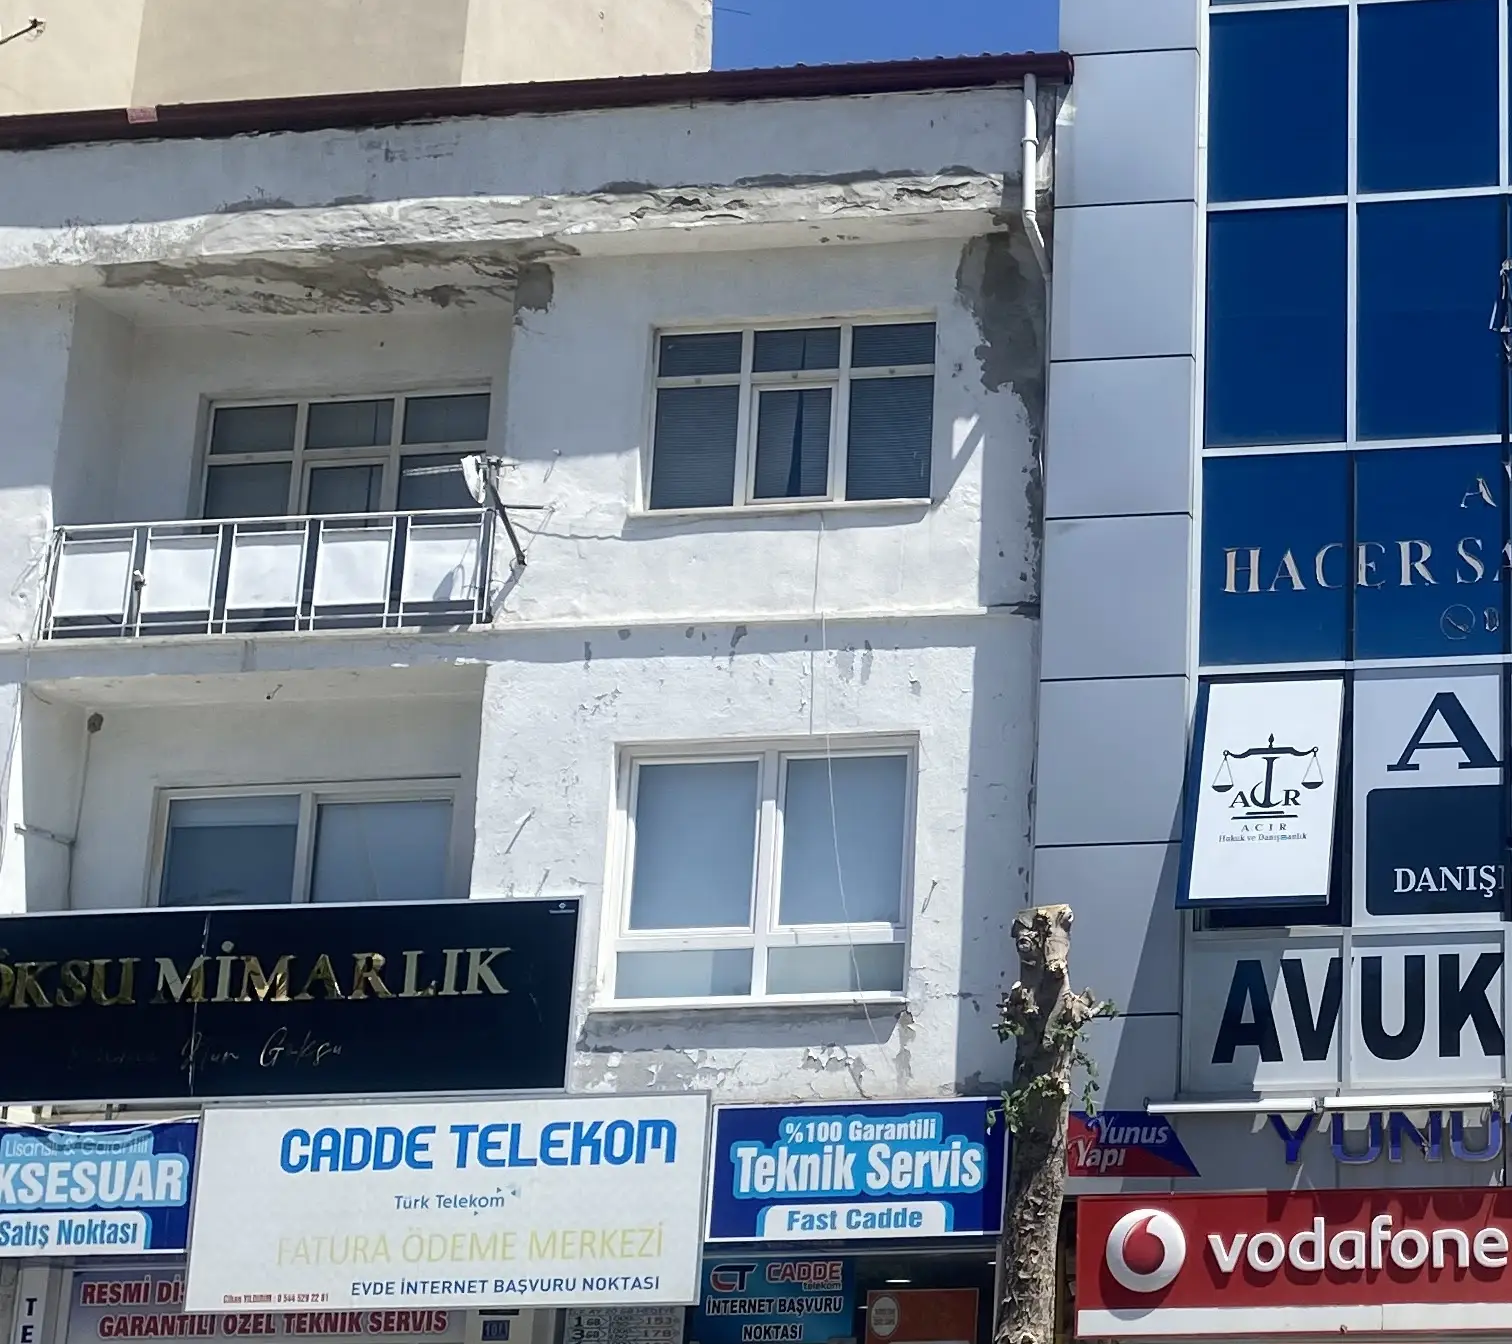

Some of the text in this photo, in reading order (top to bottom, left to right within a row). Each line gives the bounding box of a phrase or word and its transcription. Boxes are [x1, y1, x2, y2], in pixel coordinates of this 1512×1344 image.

[1223, 537, 1440, 596] HACER
[150, 940, 512, 1003] MİMARLIK
[786, 1118, 937, 1144] %100 Garantili
[1096, 1116, 1169, 1145] Yunus
[279, 1119, 678, 1174] CADDE TELEKOM
[736, 1141, 982, 1193] Teknik Servis
[394, 1192, 505, 1211] Türk Telekom
[0, 1217, 138, 1249] Satış Noktası
[787, 1207, 923, 1232] Fast Cadde
[277, 1222, 665, 1266] FATURA ÖDEME MERKEZİ
[1206, 1213, 1509, 1275] vodafone
[351, 1275, 662, 1297] EVDE İNTERNET BAŞVURU NOKTASI
[766, 1260, 844, 1284] CADDE
[802, 1281, 843, 1291] telekom
[80, 1275, 151, 1305] RESMİ
[706, 1294, 844, 1317] İNTERNET BAŞVURU
[742, 1323, 804, 1342] NOKTASI
